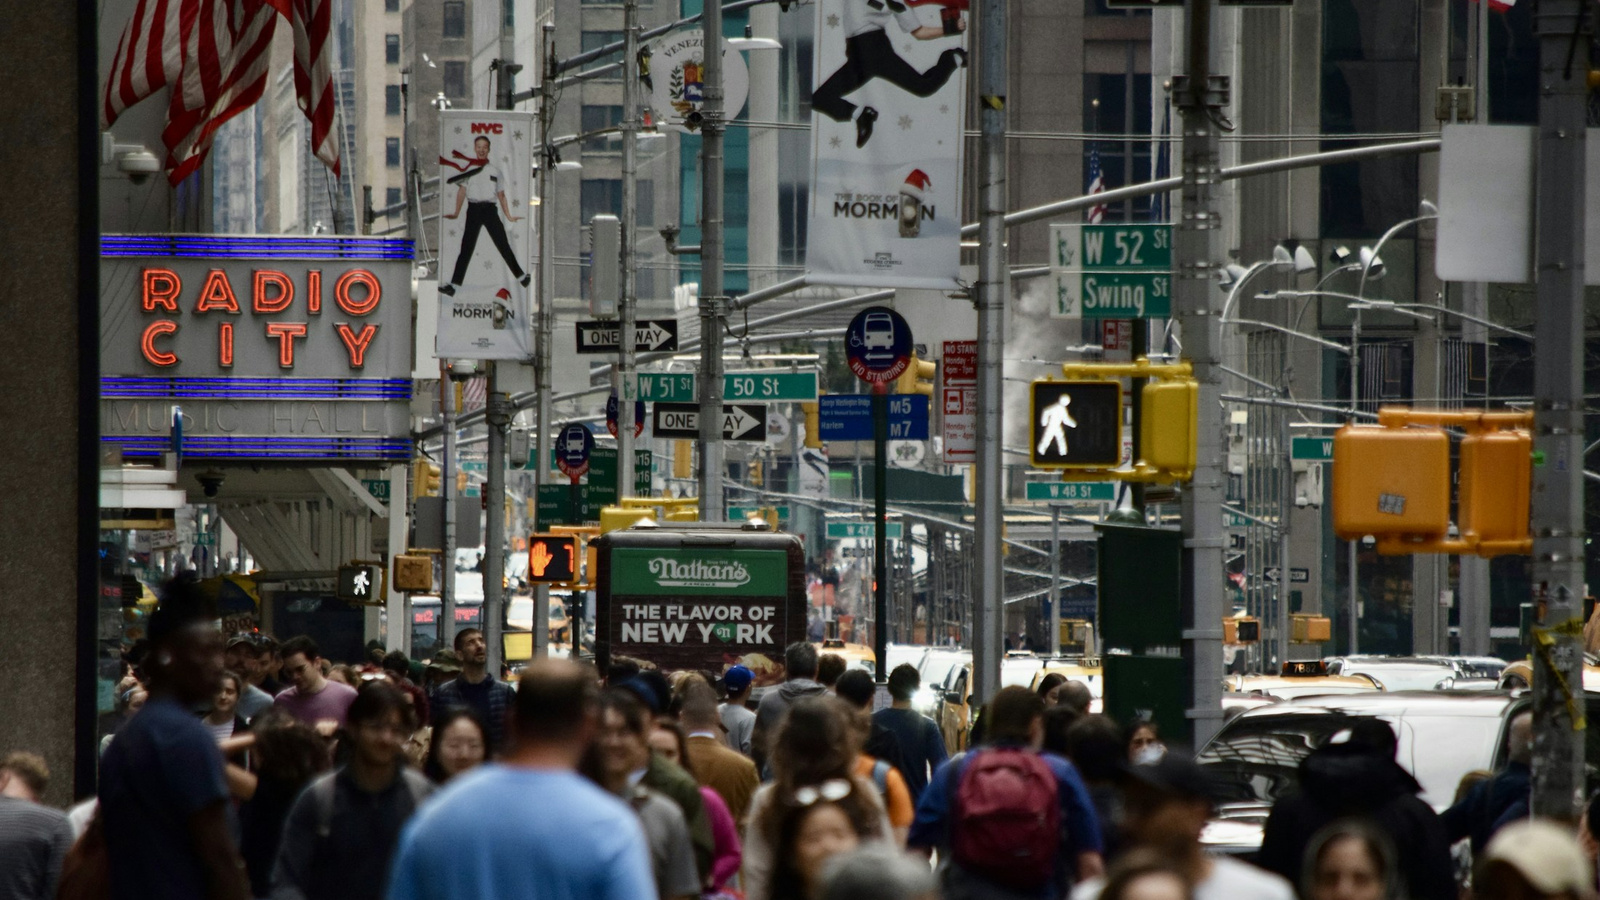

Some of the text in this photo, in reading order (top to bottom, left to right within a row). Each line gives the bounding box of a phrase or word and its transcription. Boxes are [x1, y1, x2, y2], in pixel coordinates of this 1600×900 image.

[471, 123, 503, 134] NYC
[856, 194, 882, 202] BOOK
[1084, 229, 1169, 265] W 52 St
[141, 267, 382, 316] RADIO
[1084, 277, 1168, 318] Swing St
[141, 320, 381, 368] CITY
[591, 331, 620, 344] ONE
[945, 345, 956, 354] NO
[945, 357, 966, 365] Monday
[852, 360, 905, 382] NO STANDING
[640, 377, 691, 398] W 51 St
[733, 378, 755, 396] 50
[762, 378, 779, 396] St
[890, 398, 911, 415] M5
[110, 403, 380, 433] MUSIC HALL
[665, 414, 744, 430] ONE AY
[821, 421, 844, 430] Harlem
[890, 421, 911, 437] M7
[1322, 441, 1333, 456] W
[373, 482, 385, 496] 50
[1049, 485, 1092, 497] W 48 St
[847, 526, 856, 536] W
[858, 525, 870, 536] 47
[648, 557, 746, 580] Nathan's
[622, 605, 775, 620] THE FLAVOR OF
[621, 622, 689, 643] NEW
